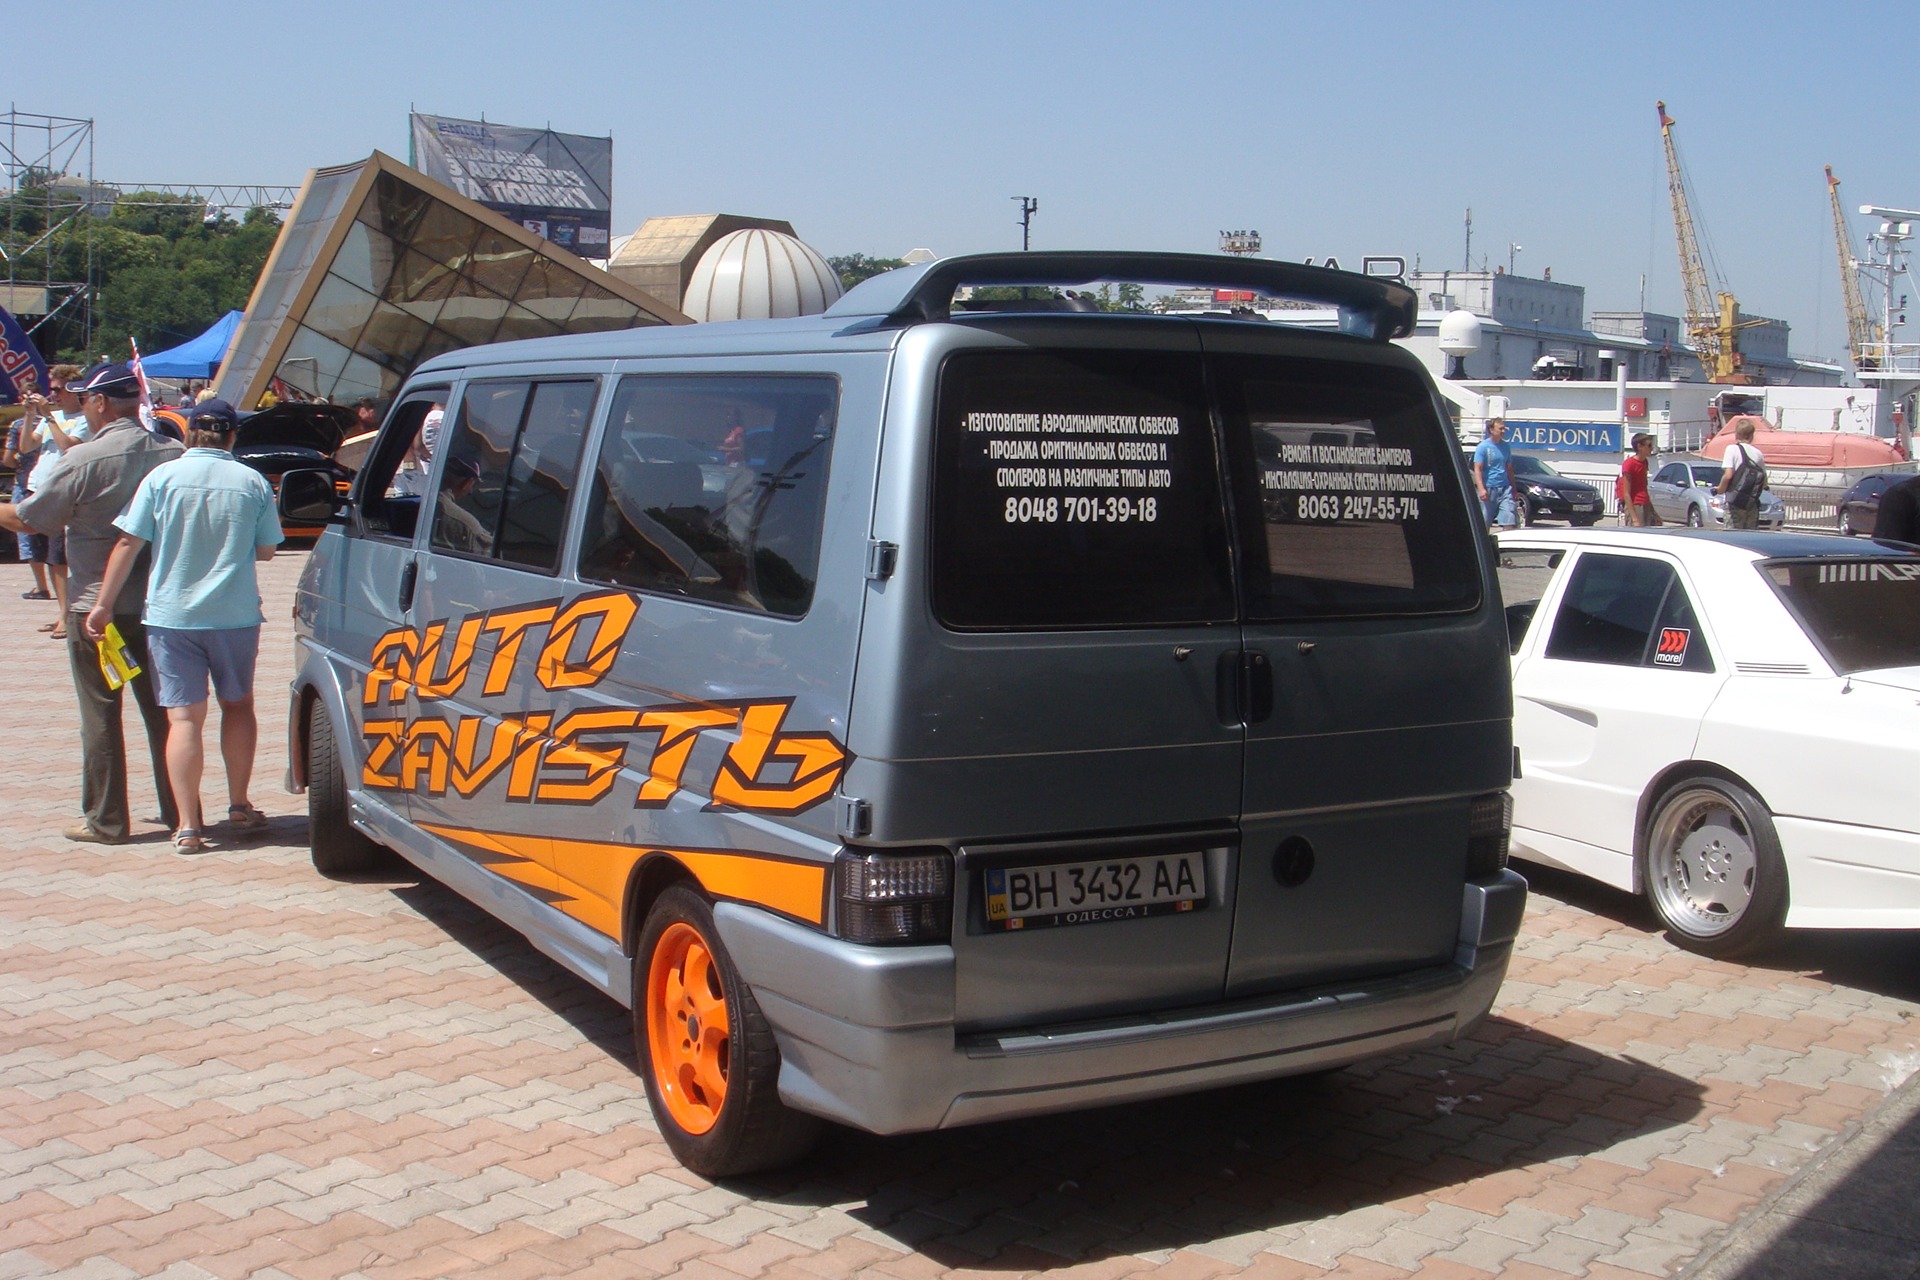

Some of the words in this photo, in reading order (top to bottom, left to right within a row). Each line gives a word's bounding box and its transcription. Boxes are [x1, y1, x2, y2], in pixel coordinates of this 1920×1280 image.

[451, 177, 490, 202] ТА
[968, 412, 1040, 433] ИЗГОТОВЛЕНИЕ
[1041, 413, 1138, 434] АЭРОДИНАМИЧЕСКИХ
[1140, 416, 1179, 435] ОБВЕСОВ
[990, 440, 1039, 460] ПРОДАЖА
[1041, 441, 1116, 460] ОРИГИНАЛЬНЫХ
[1118, 443, 1158, 461] ОБВЕСОВ
[1160, 443, 1167, 461] И
[1282, 445, 1311, 463] РЕМОНТ
[1312, 445, 1319, 463] И
[1376, 448, 1412, 466] БАМПЕРОВ
[1049, 468, 1062, 487] НА
[1064, 468, 1119, 488] РАЗЛИЧНЫЕ
[1120, 469, 1147, 488] ТИПЫ
[1148, 469, 1171, 488] АВТО
[1005, 497, 1058, 523] 8048
[1064, 497, 1157, 523] 701-39-18
[1298, 495, 1339, 519] 8063
[1343, 496, 1419, 520] 247-55-74
[361, 589, 643, 708] AUTO
[1657, 653, 1682, 663] morel
[1010, 871, 1059, 911] BH
[1068, 863, 1142, 905] 3432
[1153, 858, 1197, 898] AA
[992, 902, 1006, 914] UA
[1067, 907, 1135, 923] ОДЕССА
